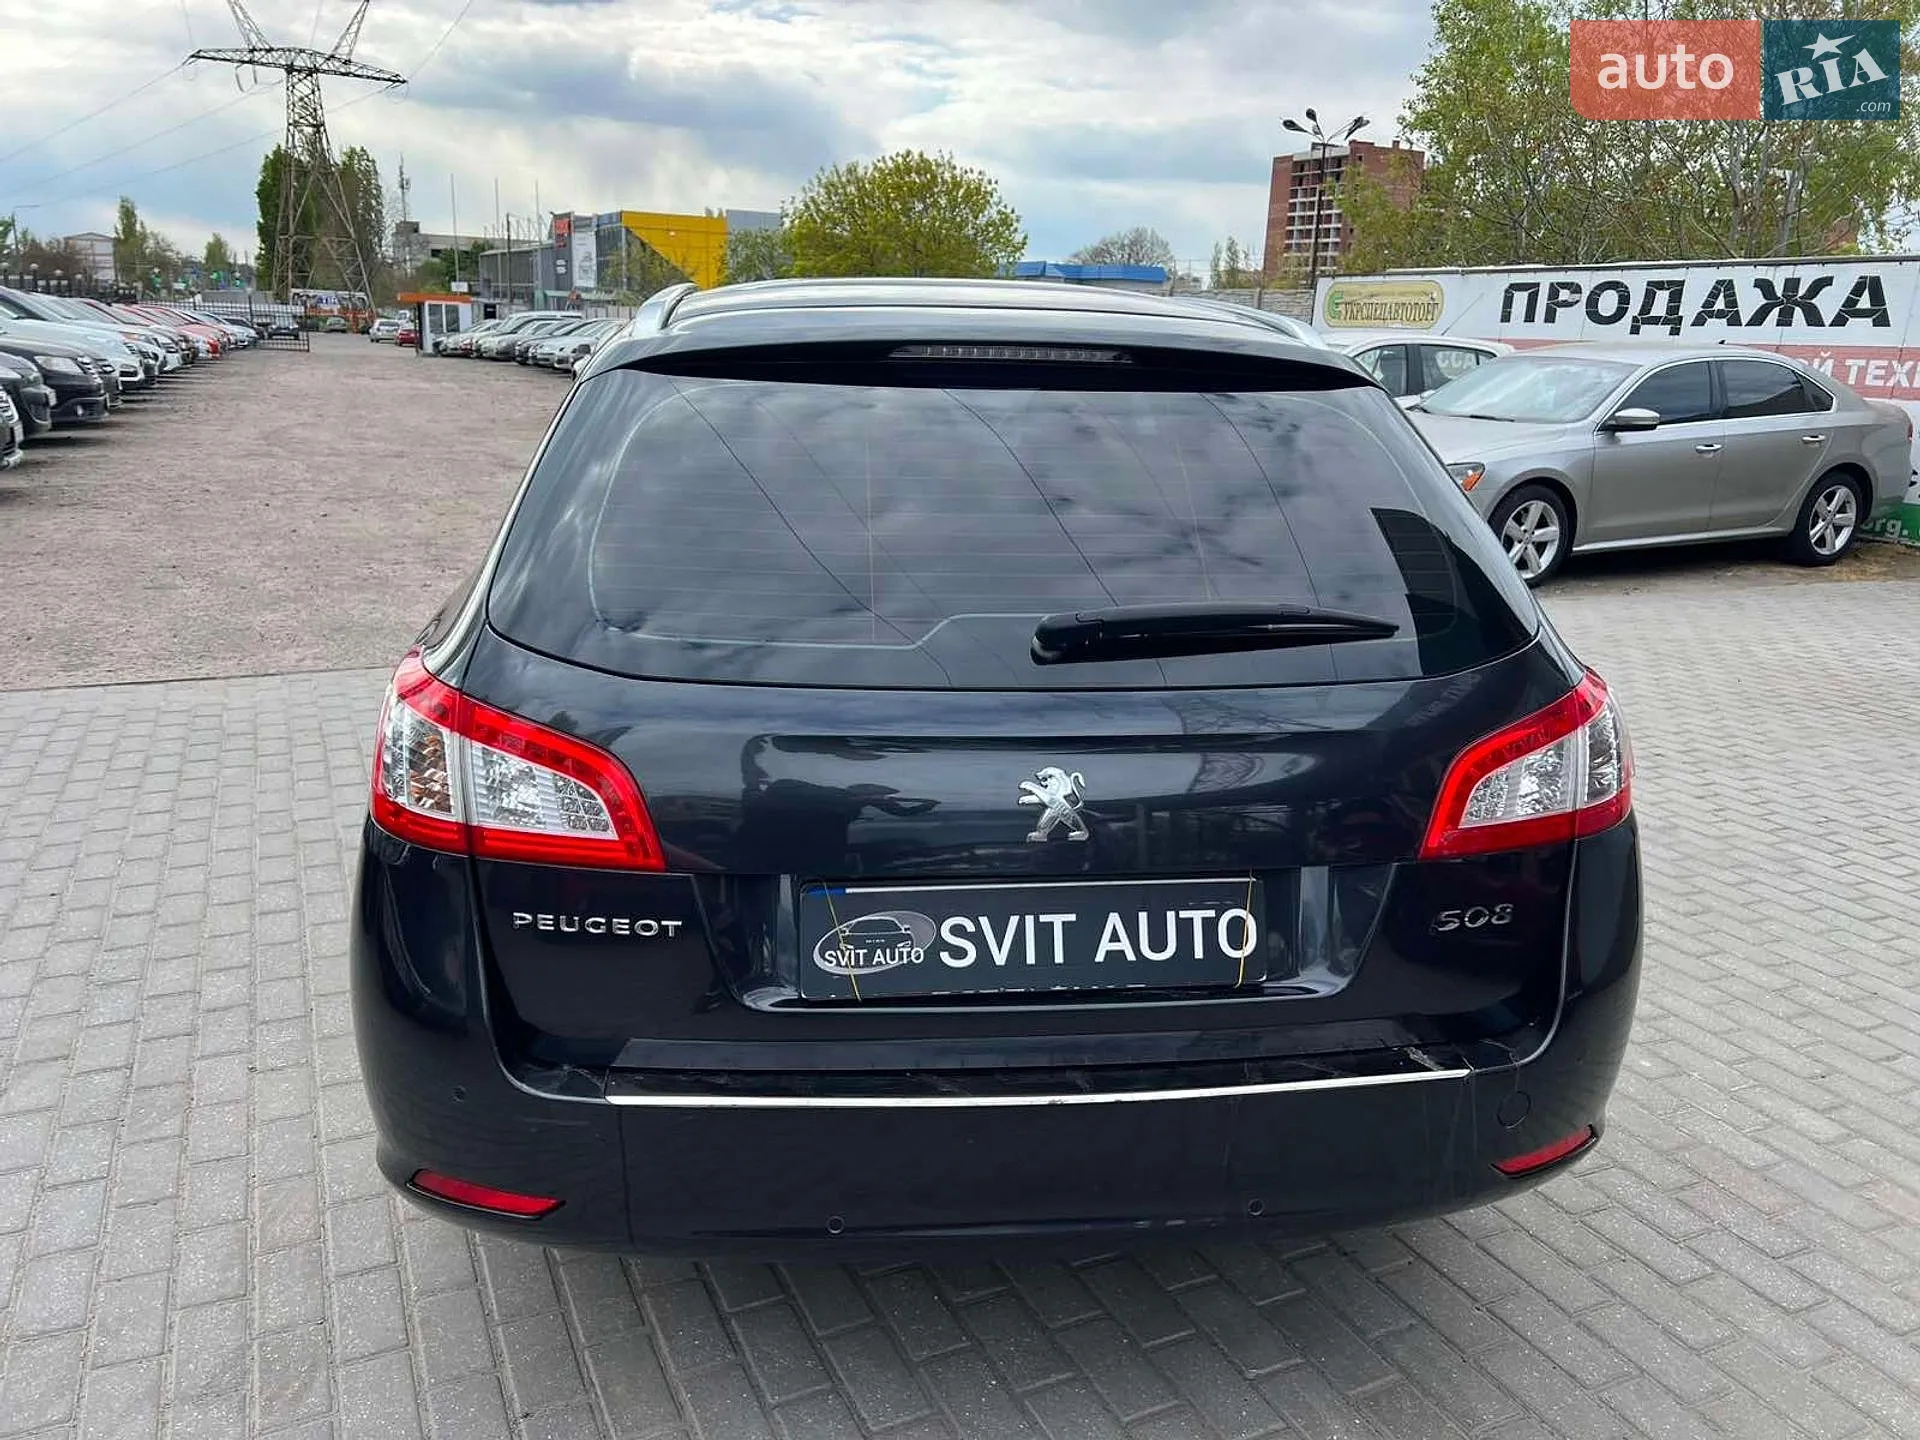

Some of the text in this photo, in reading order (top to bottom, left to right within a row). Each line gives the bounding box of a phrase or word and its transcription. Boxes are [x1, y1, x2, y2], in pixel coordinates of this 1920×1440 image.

[1499, 274, 1892, 336] ПРОДАЖА
[512, 911, 683, 938] PEUGEOT
[1435, 903, 1514, 932] 508
[938, 908, 1258, 969] SVIT AUTO
[824, 947, 924, 967] SVIT AUTO
